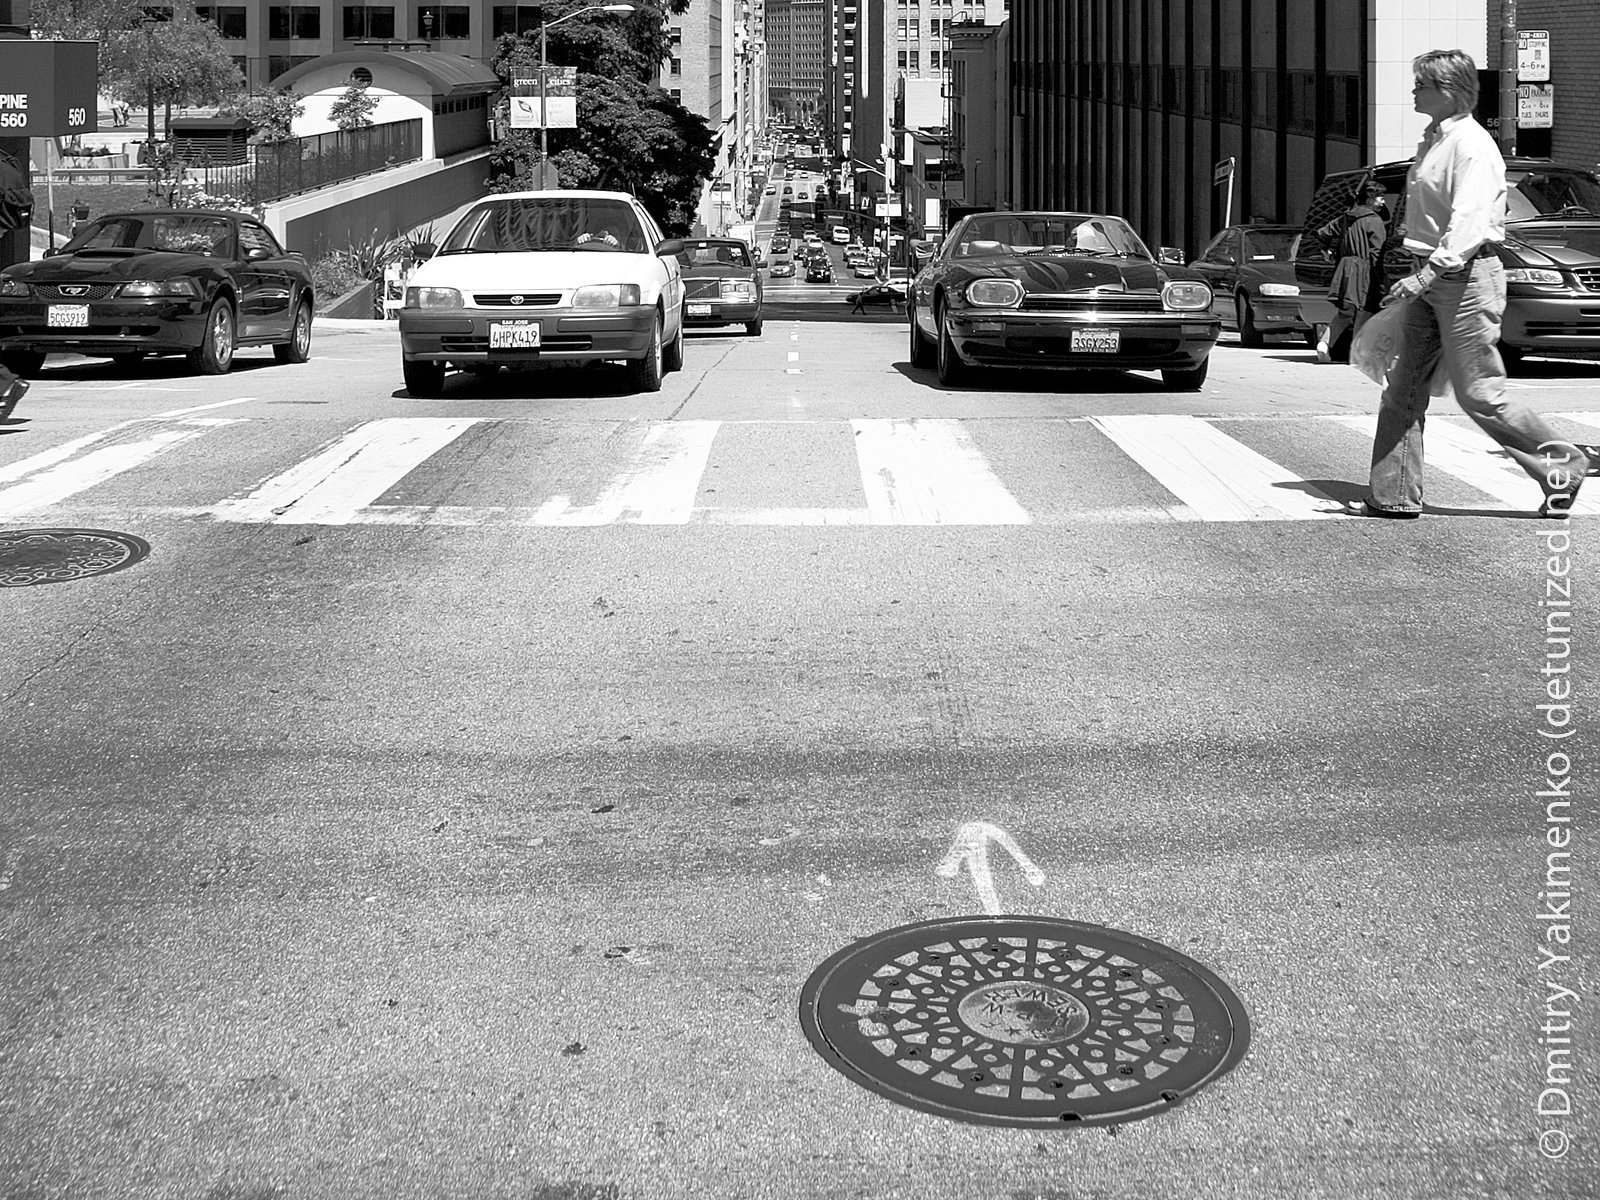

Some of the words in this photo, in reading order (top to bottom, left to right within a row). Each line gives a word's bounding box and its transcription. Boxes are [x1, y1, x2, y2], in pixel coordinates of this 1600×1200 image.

[1519, 86, 1529, 98] NO
[1530, 88, 1551, 98] PARKING
[0, 94, 28, 109] PINE
[0, 112, 28, 128] 560
[68, 107, 86, 126] 560
[50, 312, 86, 324] 5CGS919
[492, 330, 538, 344] 4HPK419
[1073, 337, 1118, 350] 3SGX253
[983, 987, 1078, 1018] SEWER
